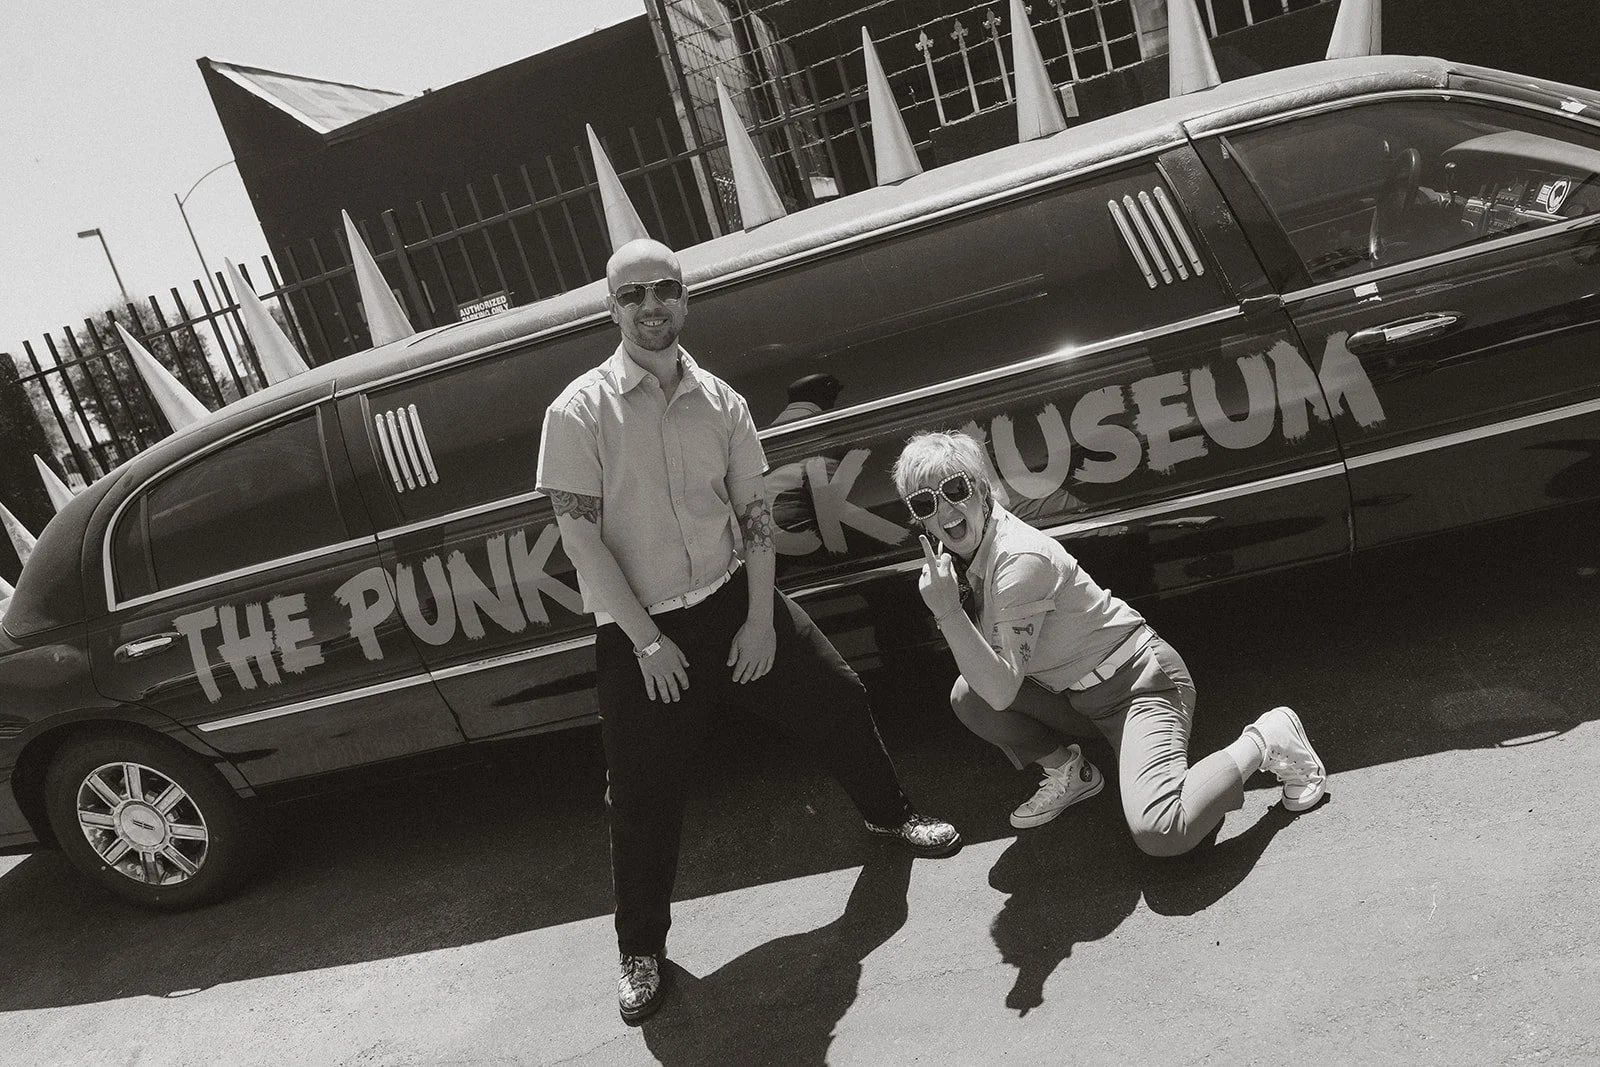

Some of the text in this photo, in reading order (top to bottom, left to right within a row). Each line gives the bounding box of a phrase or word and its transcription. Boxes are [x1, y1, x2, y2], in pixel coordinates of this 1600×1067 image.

[459, 295, 507, 317] AUTHORIZED
[491, 302, 509, 315] ONLY
[173, 592, 325, 704] THE
[333, 523, 585, 661] PUNK
[763, 448, 912, 556] CK
